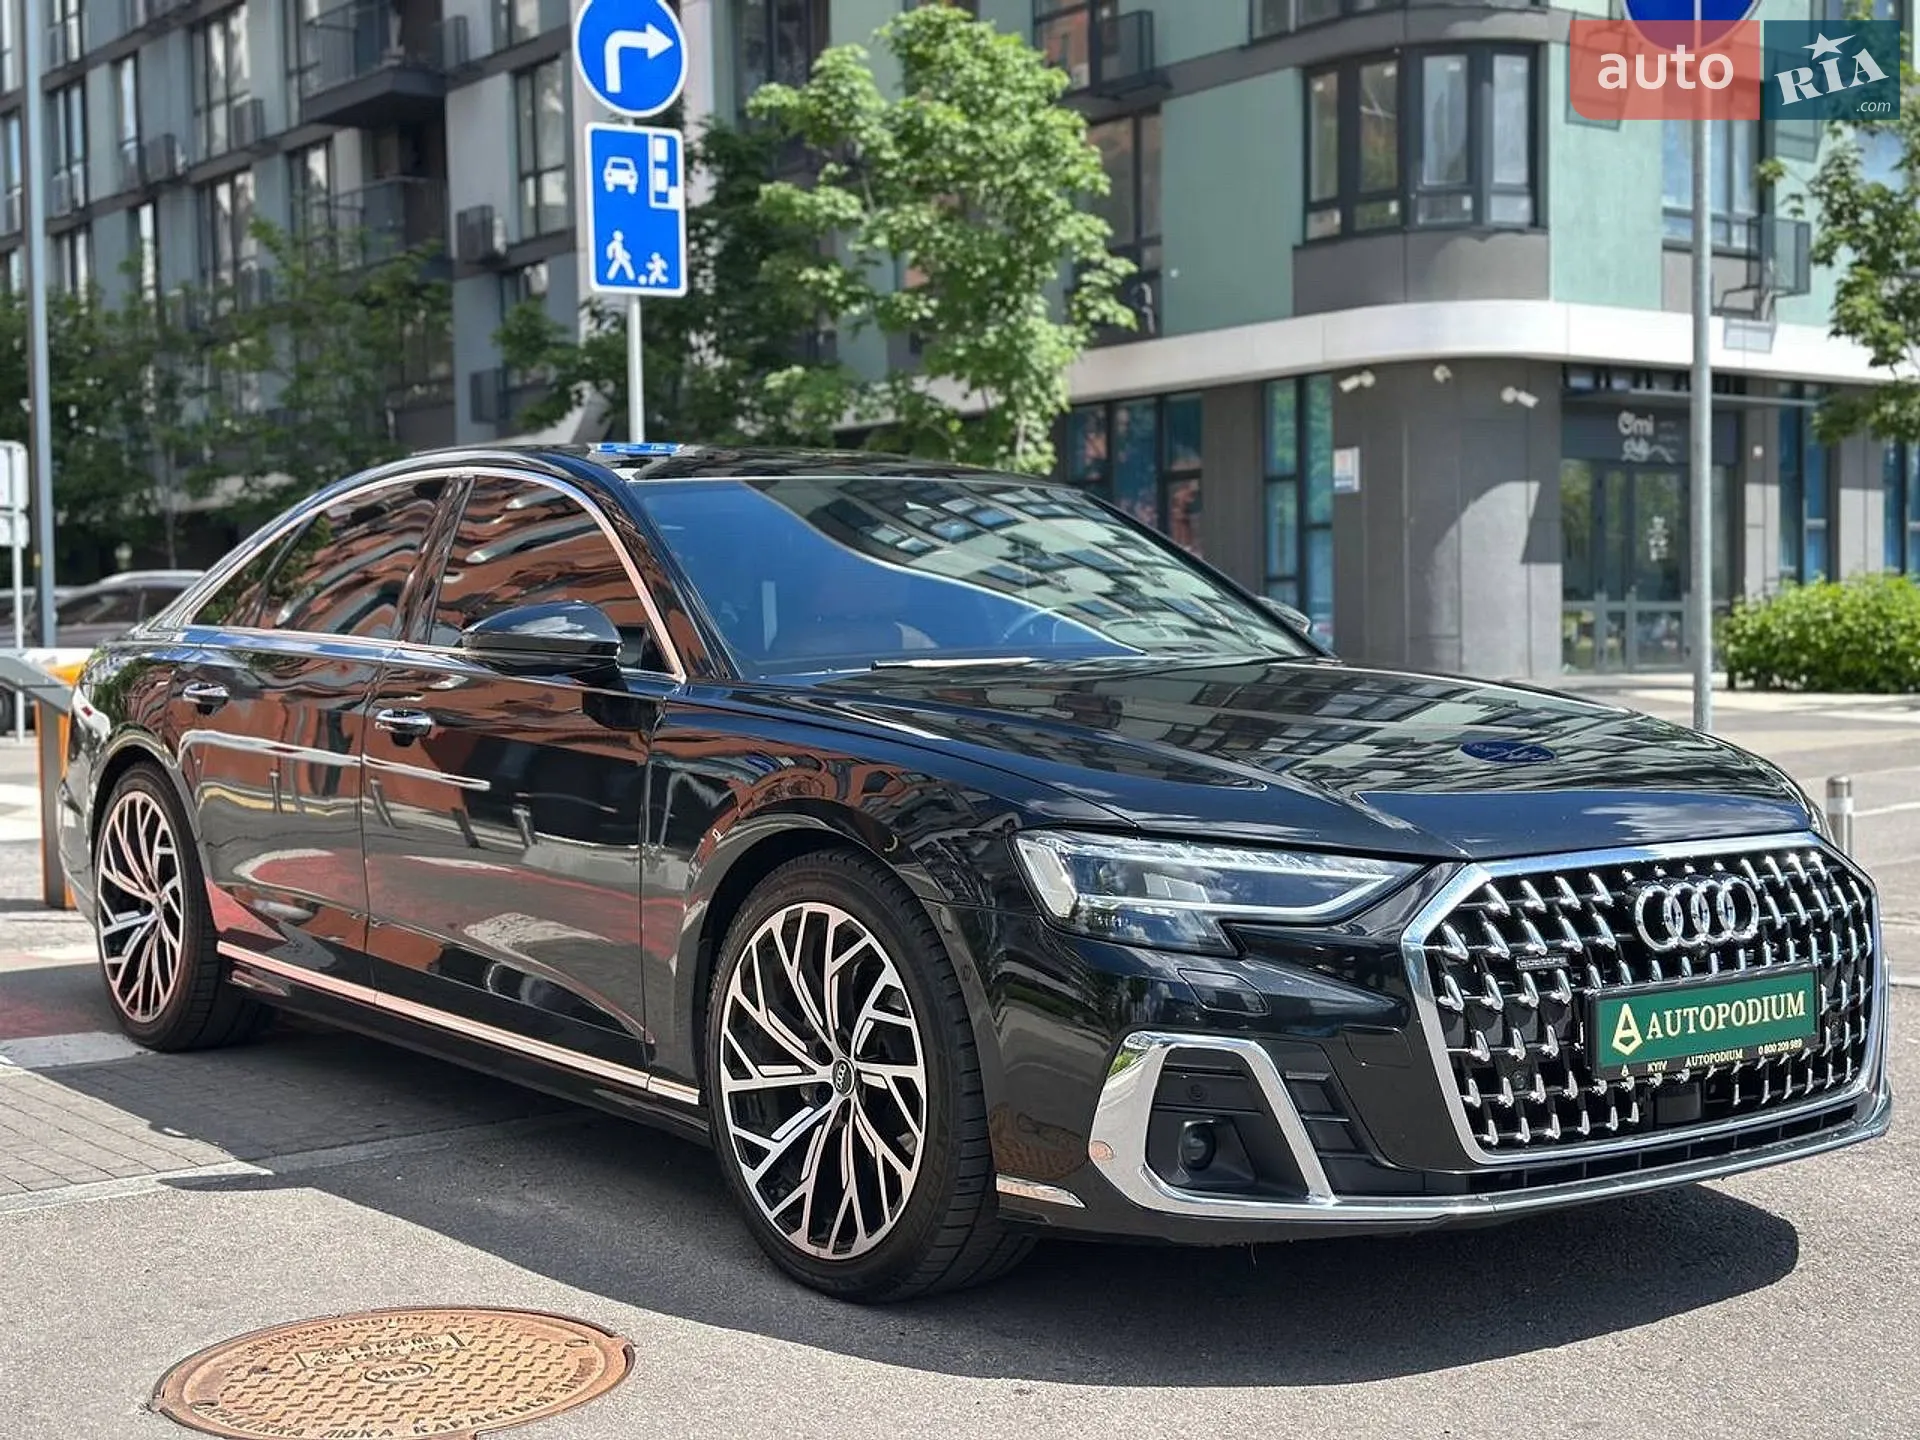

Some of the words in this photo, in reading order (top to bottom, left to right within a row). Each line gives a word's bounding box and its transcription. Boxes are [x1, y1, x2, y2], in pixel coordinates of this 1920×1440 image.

[1646, 990, 1806, 1040] AUTOPODIUM
[1684, 1048, 1744, 1067] AUTOPODIUM
[319, 1427, 395, 1439] ЛЮКА
